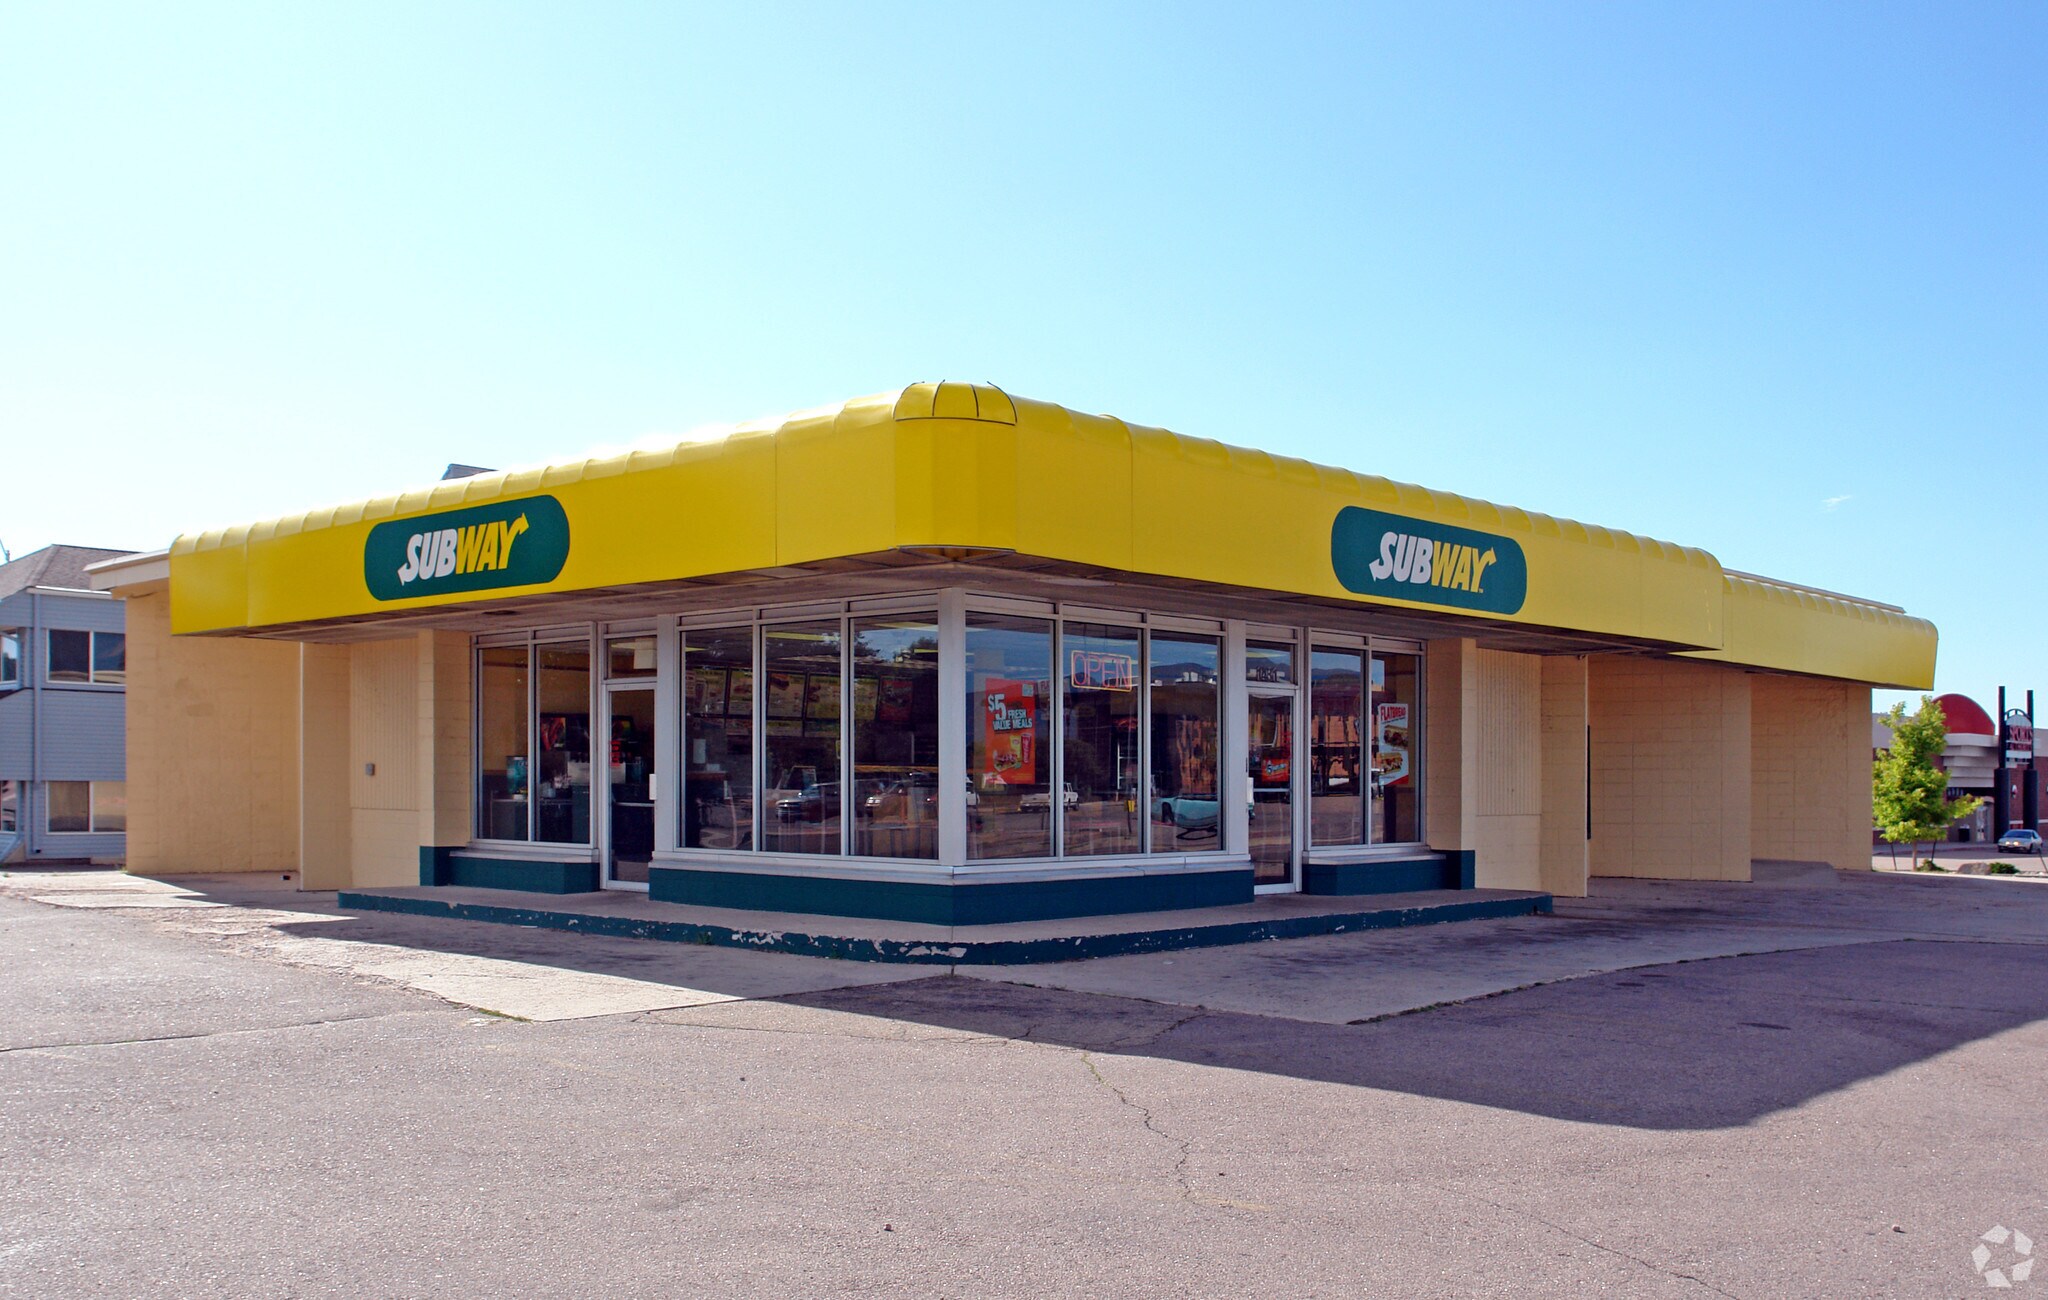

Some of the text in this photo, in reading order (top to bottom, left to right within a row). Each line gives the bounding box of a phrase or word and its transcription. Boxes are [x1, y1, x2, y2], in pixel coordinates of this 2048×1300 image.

[398, 512, 530, 586] SUBWAY
[1369, 531, 1497, 593] SUBWAY
[1073, 652, 1131, 690] OPEN
[988, 693, 1027, 721] $5 FRESH
[993, 717, 1033, 731] VALUE MEALS
